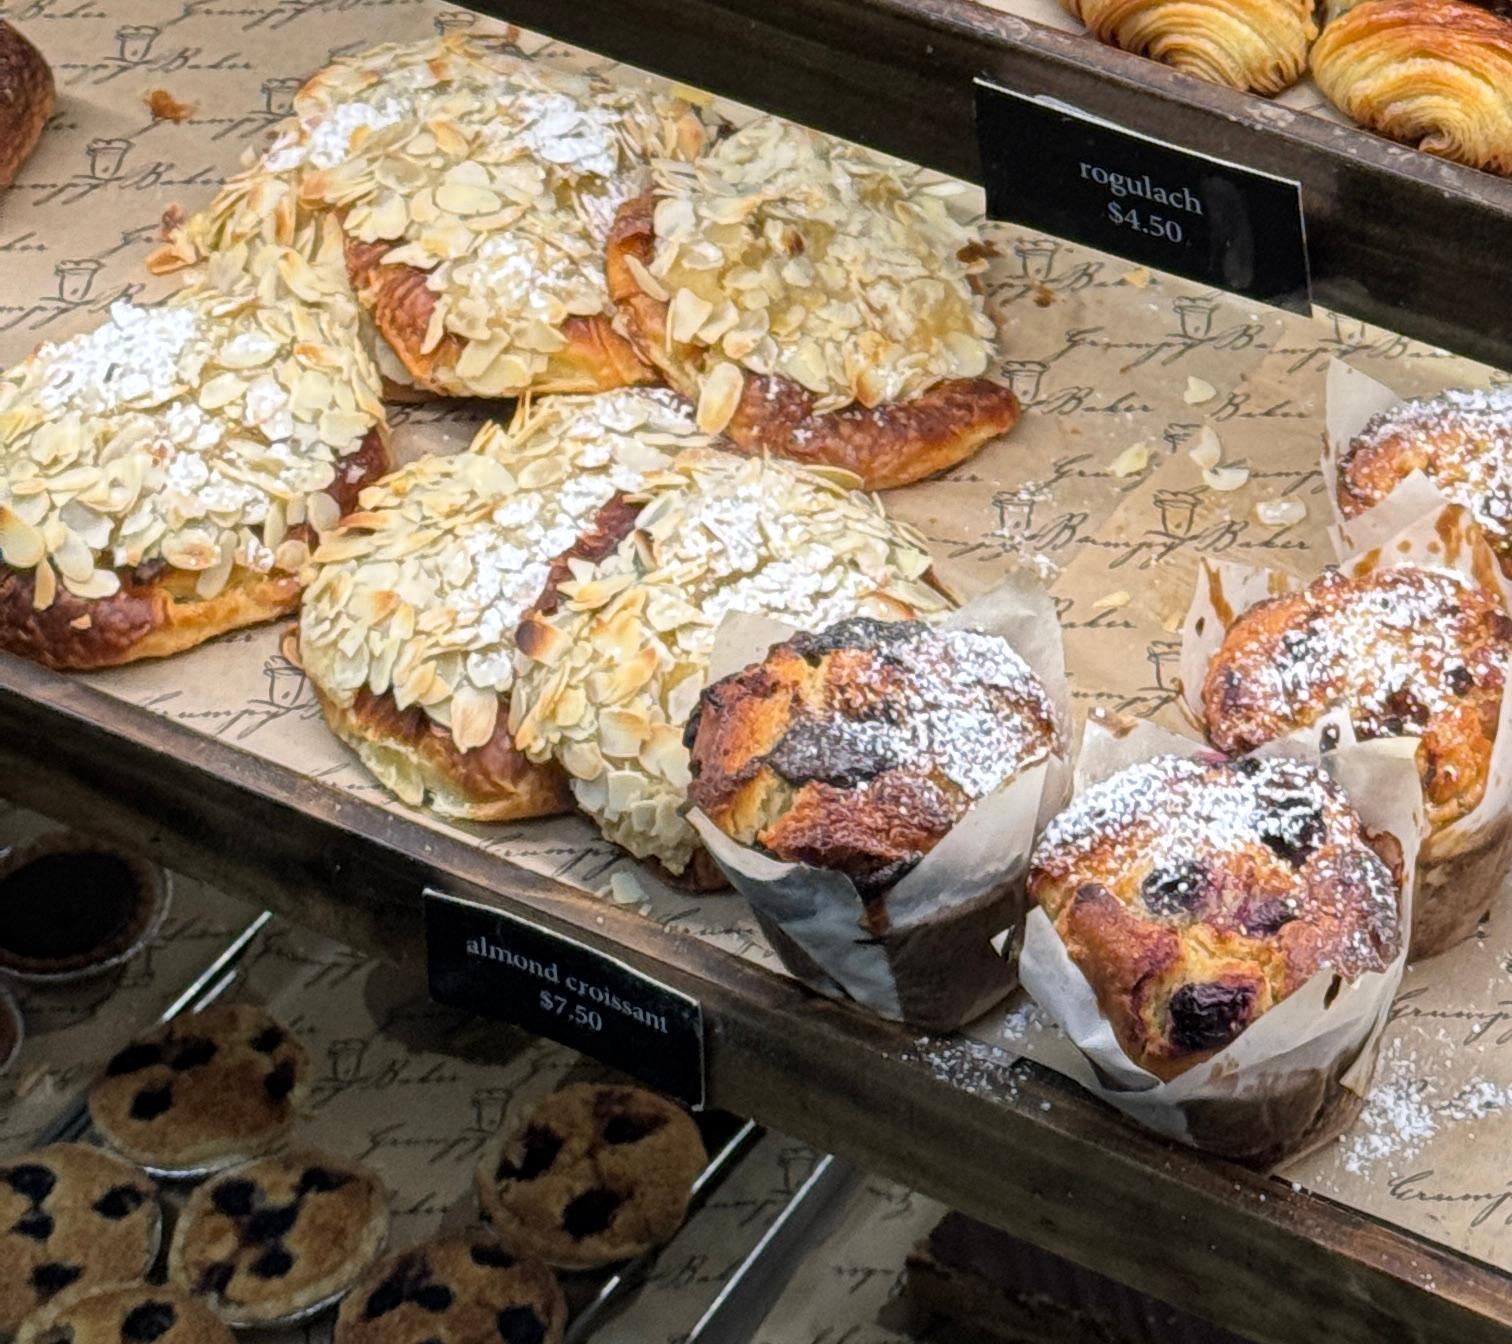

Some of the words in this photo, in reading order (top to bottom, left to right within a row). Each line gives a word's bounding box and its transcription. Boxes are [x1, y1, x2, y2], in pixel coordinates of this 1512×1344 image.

[1079, 162, 1203, 215] rogulach
[1107, 200, 1182, 243] $4.50
[466, 936, 560, 983] almond
[565, 974, 669, 1034] croissant
[539, 989, 603, 1032] $7.50
